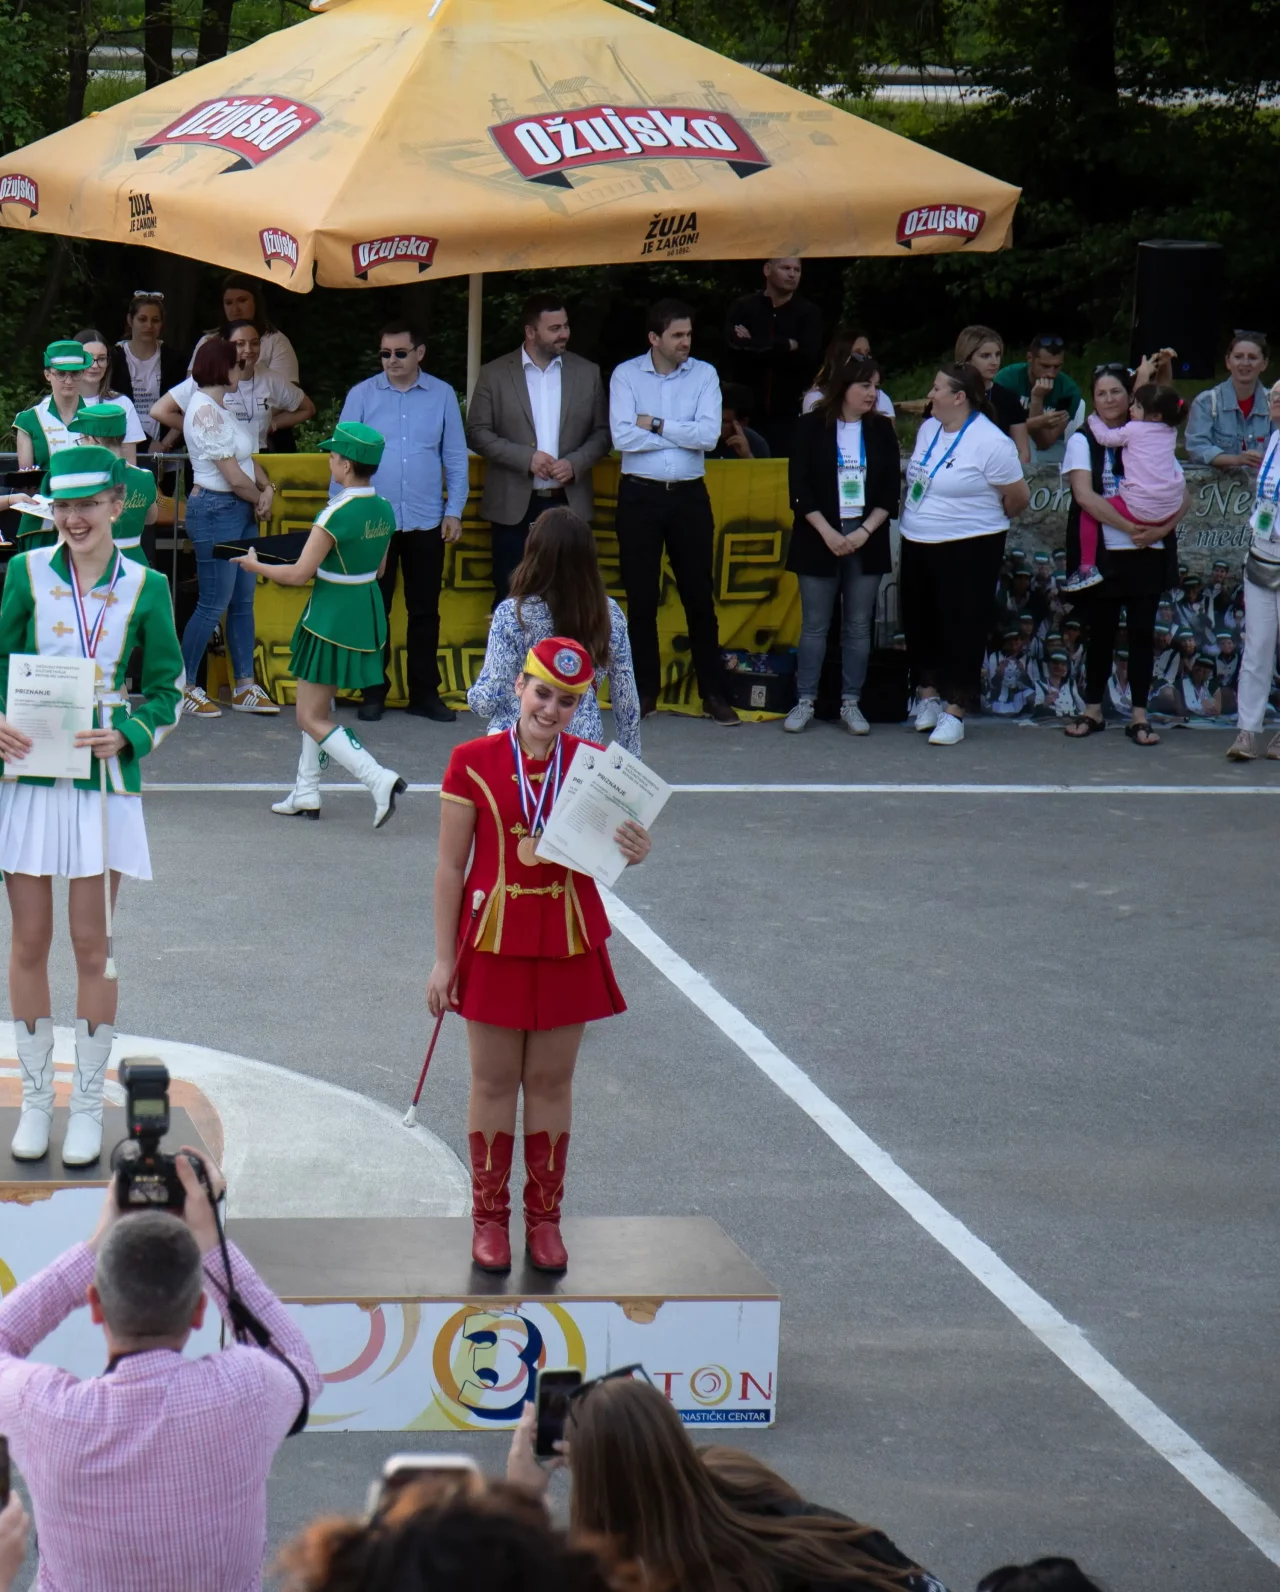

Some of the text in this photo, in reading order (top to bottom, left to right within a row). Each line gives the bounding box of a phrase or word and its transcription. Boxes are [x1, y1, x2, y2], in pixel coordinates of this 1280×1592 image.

[166, 97, 303, 152] Ožujsko
[514, 107, 739, 166] Ožujsko
[0, 176, 36, 204] Ožujsko
[128, 189, 154, 218] ŽUJA
[129, 216, 157, 233] JE ZAKON!
[646, 211, 697, 240] ŽUJA
[904, 205, 979, 235] Ožujsko
[262, 230, 297, 264] Ožujsko
[358, 237, 430, 268] Ožujsko
[641, 232, 699, 255] JE ZAKON!
[15, 688, 51, 696] PRIZNANJE
[597, 772, 627, 797] PRIZNANJE
[458, 1311, 544, 1420] 3
[653, 1365, 773, 1405] TON
[679, 1411, 766, 1421] NASTIČKI CENTAR
